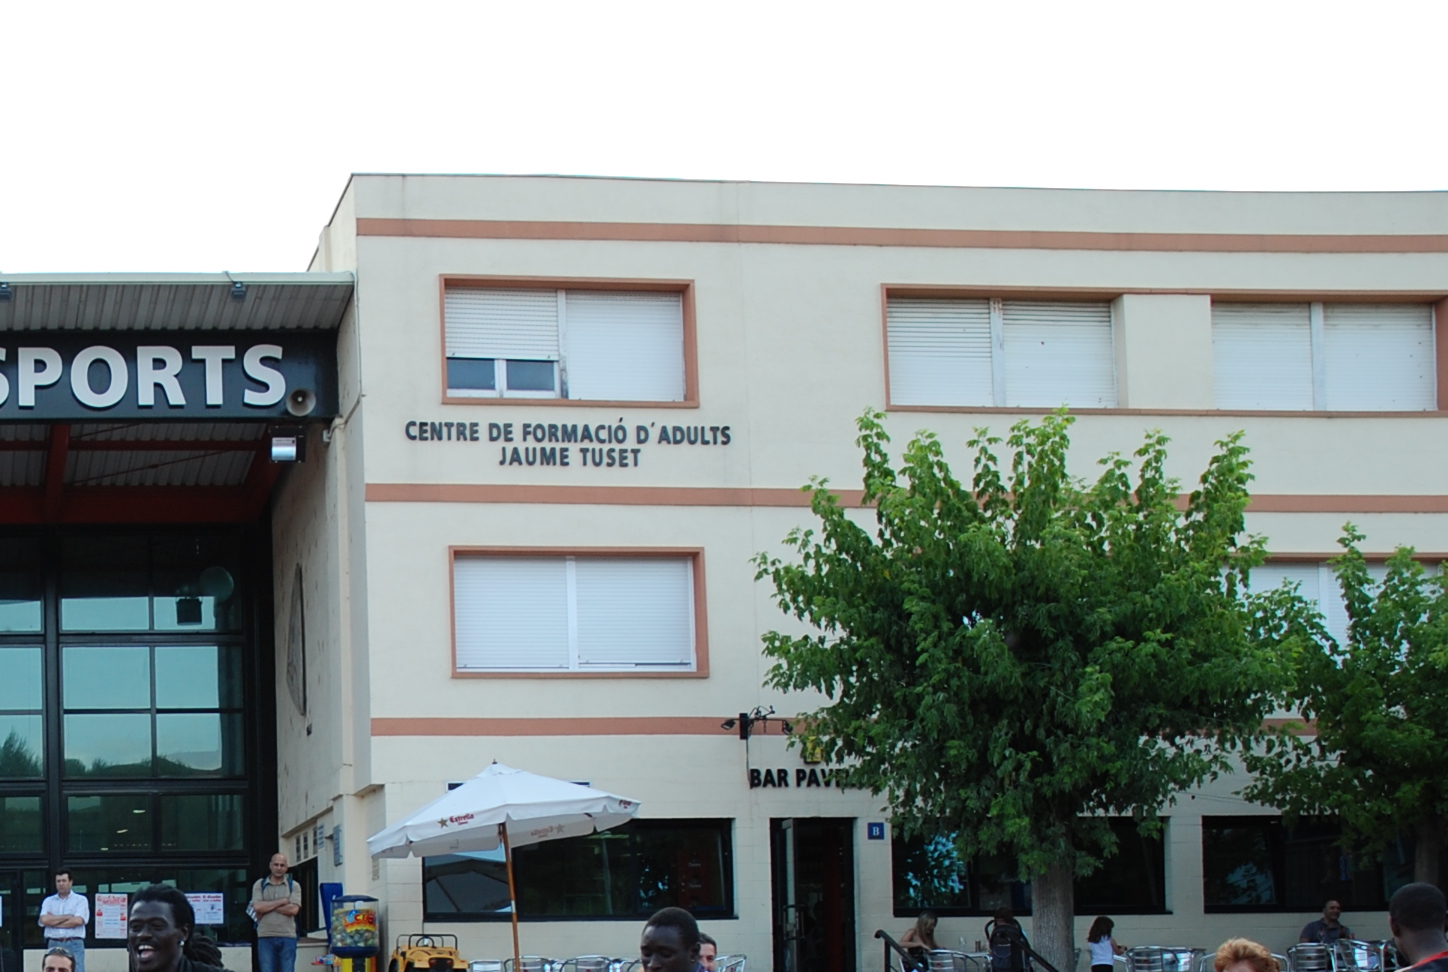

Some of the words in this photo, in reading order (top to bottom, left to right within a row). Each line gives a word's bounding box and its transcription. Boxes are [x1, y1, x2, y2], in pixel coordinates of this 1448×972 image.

[405, 420, 480, 442] CENTRE
[488, 422, 514, 442] DE
[522, 417, 628, 445] FORMACIÓ
[499, 446, 570, 467] JAUME
[579, 447, 642, 468] TUSET
[749, 768, 790, 789] BAR
[872, 826, 880, 836] B
